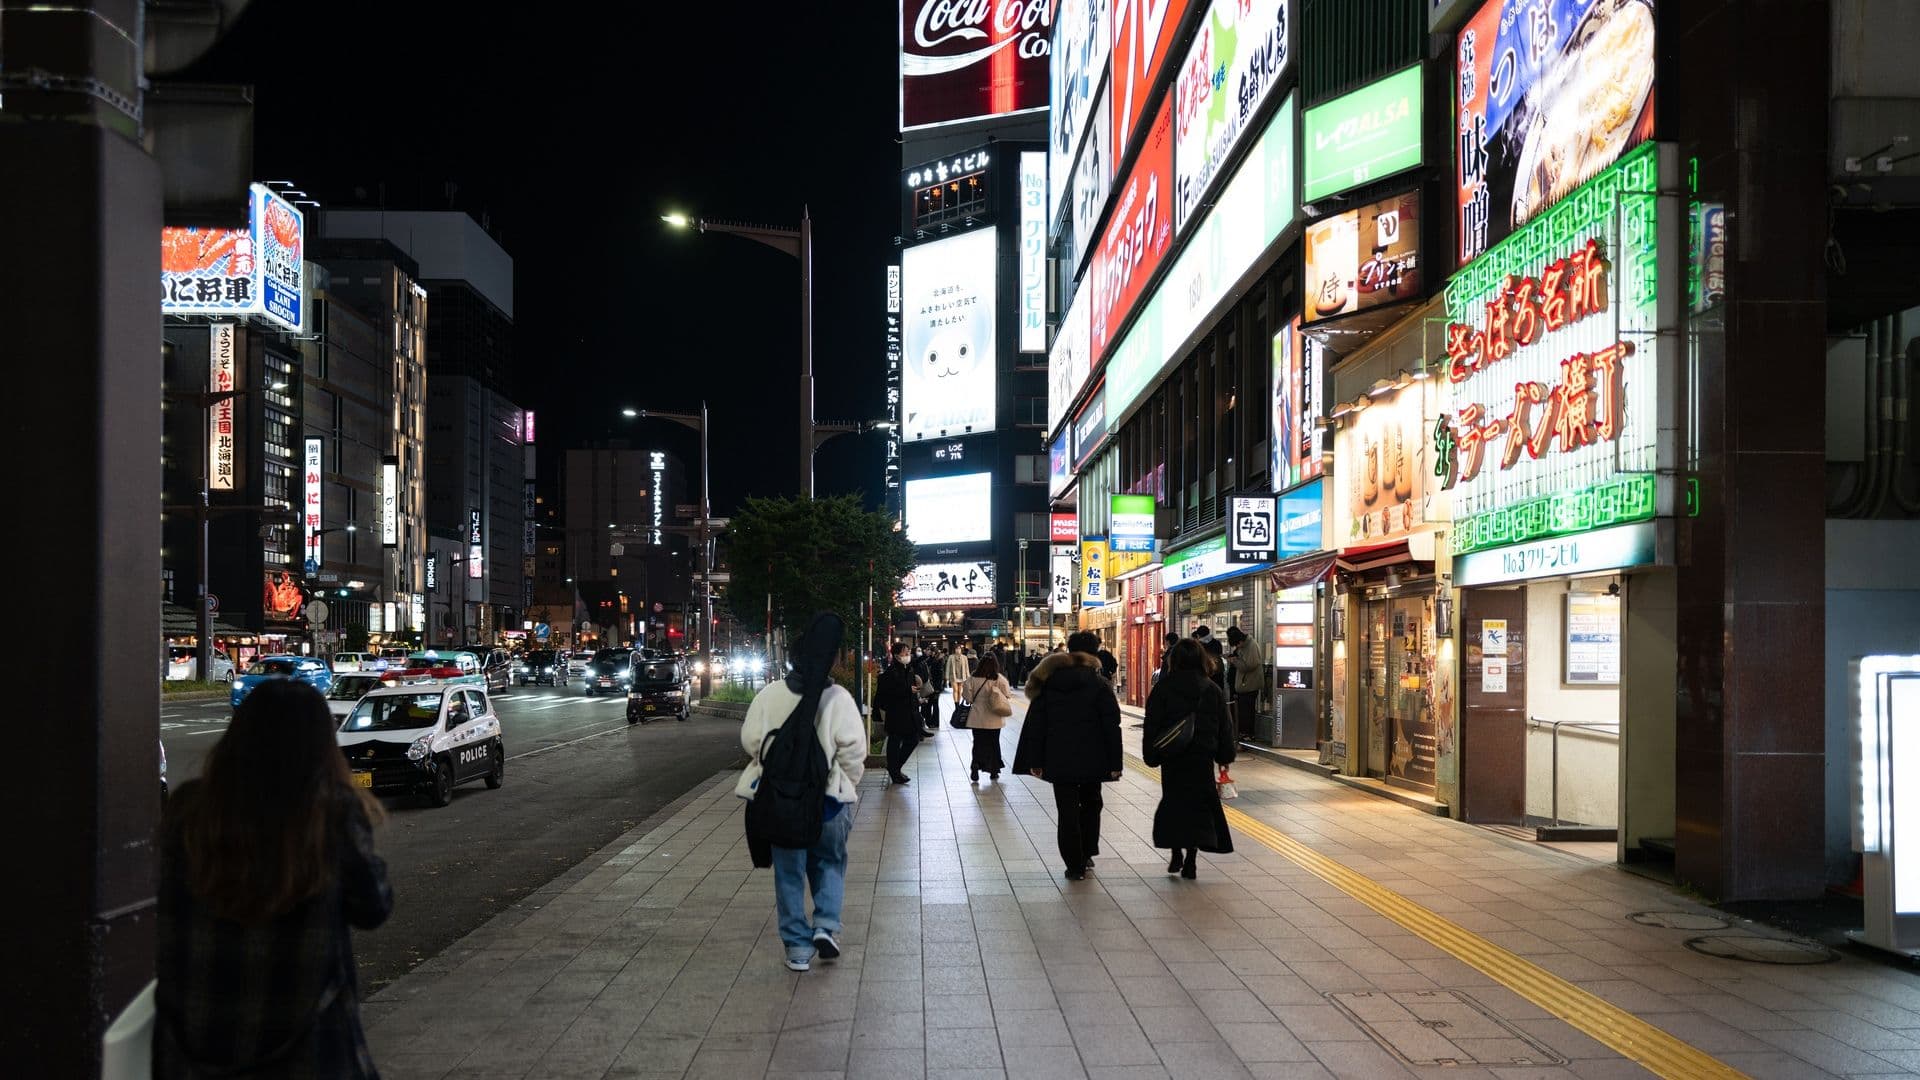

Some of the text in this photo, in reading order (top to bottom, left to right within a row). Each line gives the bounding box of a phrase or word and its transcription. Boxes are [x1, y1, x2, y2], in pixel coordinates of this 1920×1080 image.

[1019, 32, 1051, 59] Co
[1460, 29, 1488, 265] 究極の味噌
[1178, 173, 1190, 226] 1F
[1025, 220, 1042, 330] グリーンビル
[1361, 252, 1416, 287] プリン本舗
[274, 292, 291, 308] KANI
[1315, 272, 1338, 304] 侍
[269, 301, 296, 323] SHOGUN
[920, 296, 978, 315] ふさわしい空気で
[1448, 236, 1610, 383] さっぽろ名所
[1459, 340, 1634, 482] ラーメン横丁
[1113, 520, 1153, 529] FamilyMart
[1241, 518, 1267, 539] 牛角
[1087, 567, 1101, 595] 松屋
[460, 744, 488, 765] POLICE
